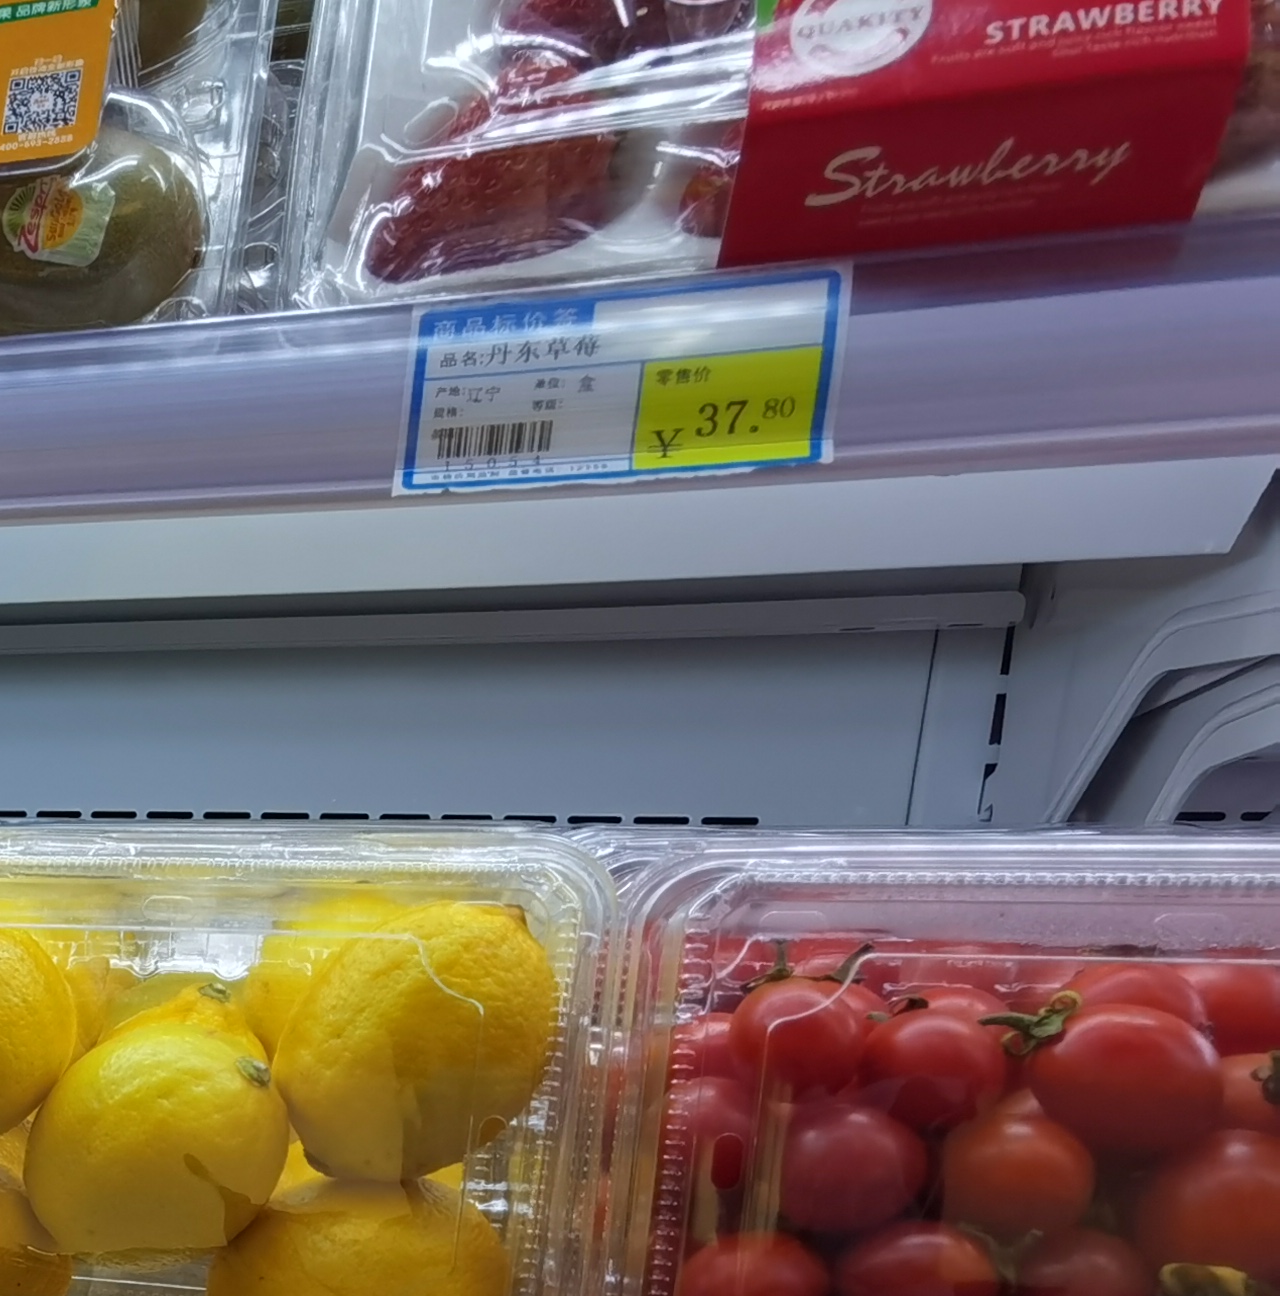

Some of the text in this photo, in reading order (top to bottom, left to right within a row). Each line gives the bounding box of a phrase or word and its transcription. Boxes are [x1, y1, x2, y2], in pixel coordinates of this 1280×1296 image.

[984, 0, 1223, 45] STRAWBERRY
[804, 137, 1132, 207] Strawberry
[433, 307, 579, 341] 商品标价签
[655, 366, 712, 386] 零售价
[695, 395, 797, 440] 37.80
